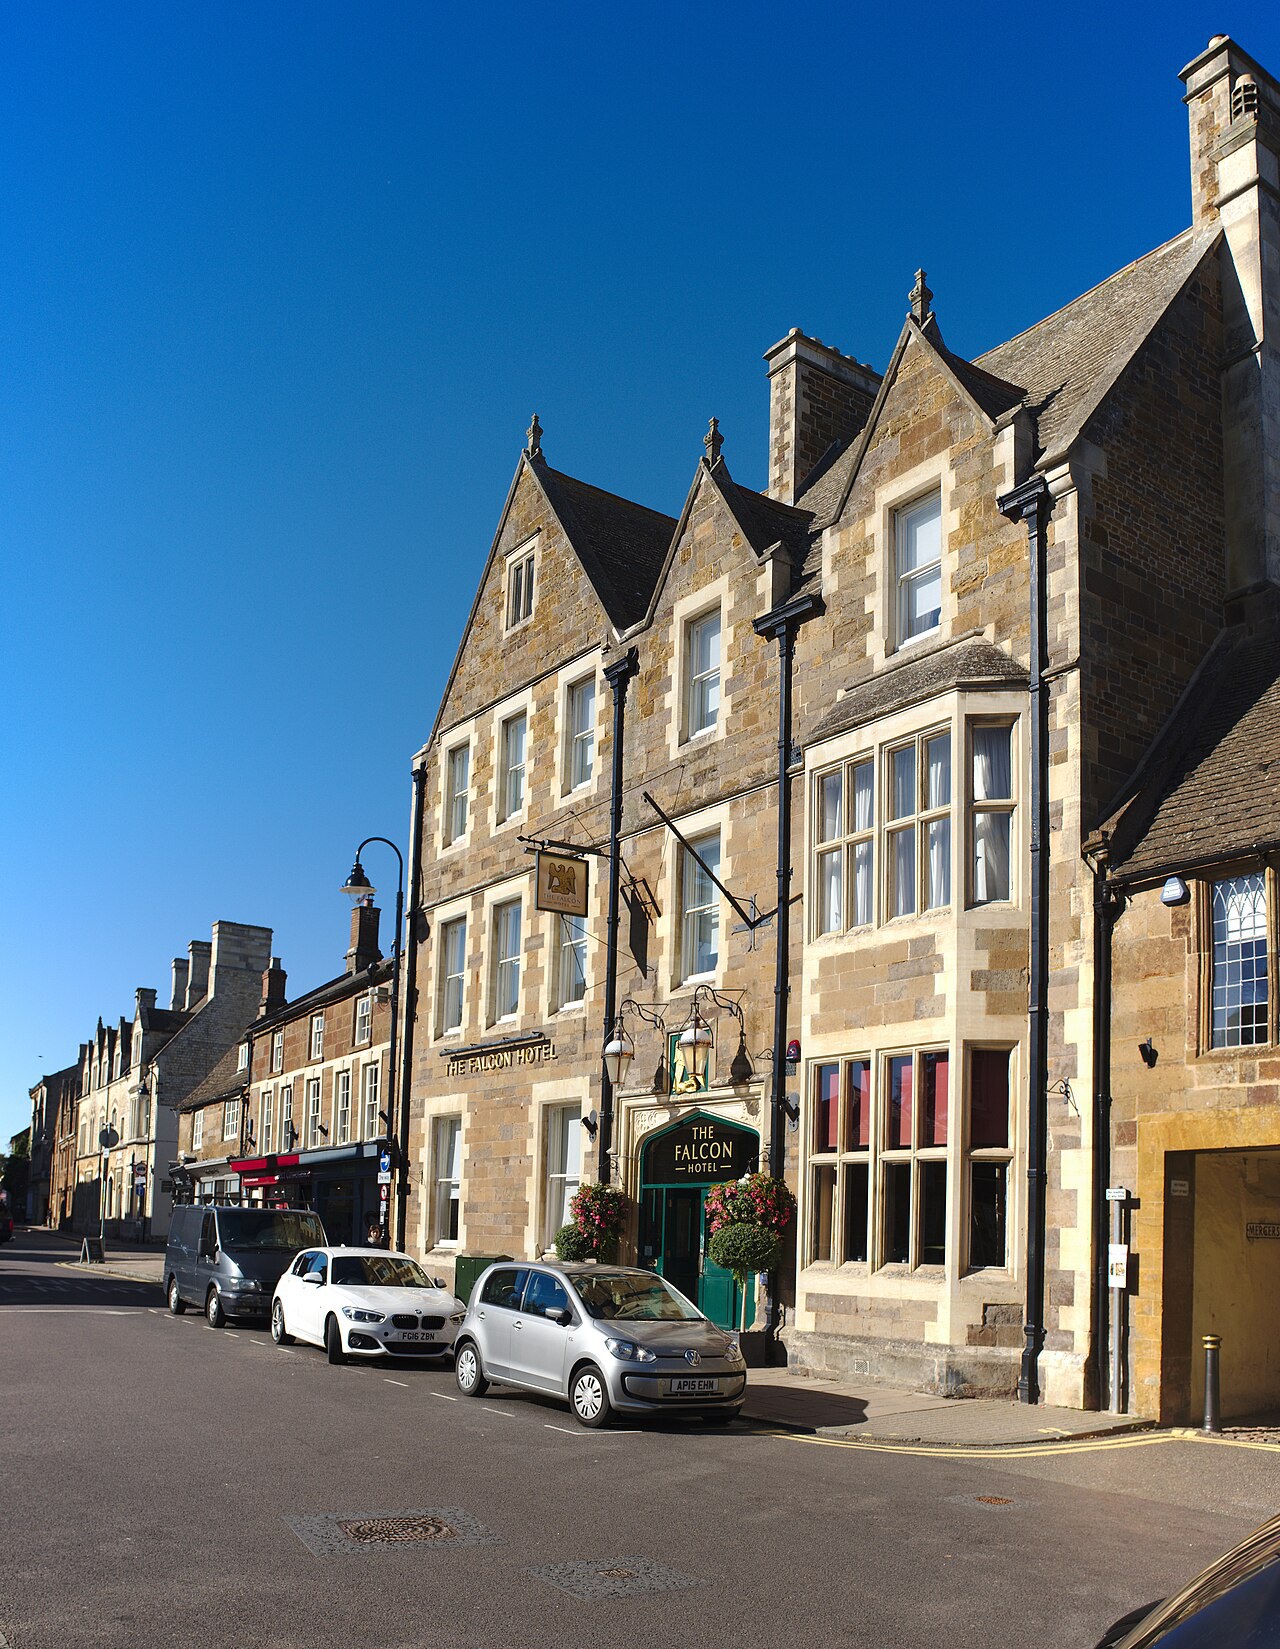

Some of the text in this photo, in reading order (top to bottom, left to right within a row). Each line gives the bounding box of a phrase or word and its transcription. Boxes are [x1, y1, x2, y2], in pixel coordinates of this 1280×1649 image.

[543, 892, 581, 904] THE FALCON
[445, 1044, 558, 1077] THE FALCON HOTEL
[692, 1125, 714, 1140] THE
[675, 1141, 733, 1161] FALCON
[687, 1162, 717, 1173] HOTEL
[420, 1332, 435, 1341] ZBN
[676, 1380, 714, 1391] AP15 EHN
